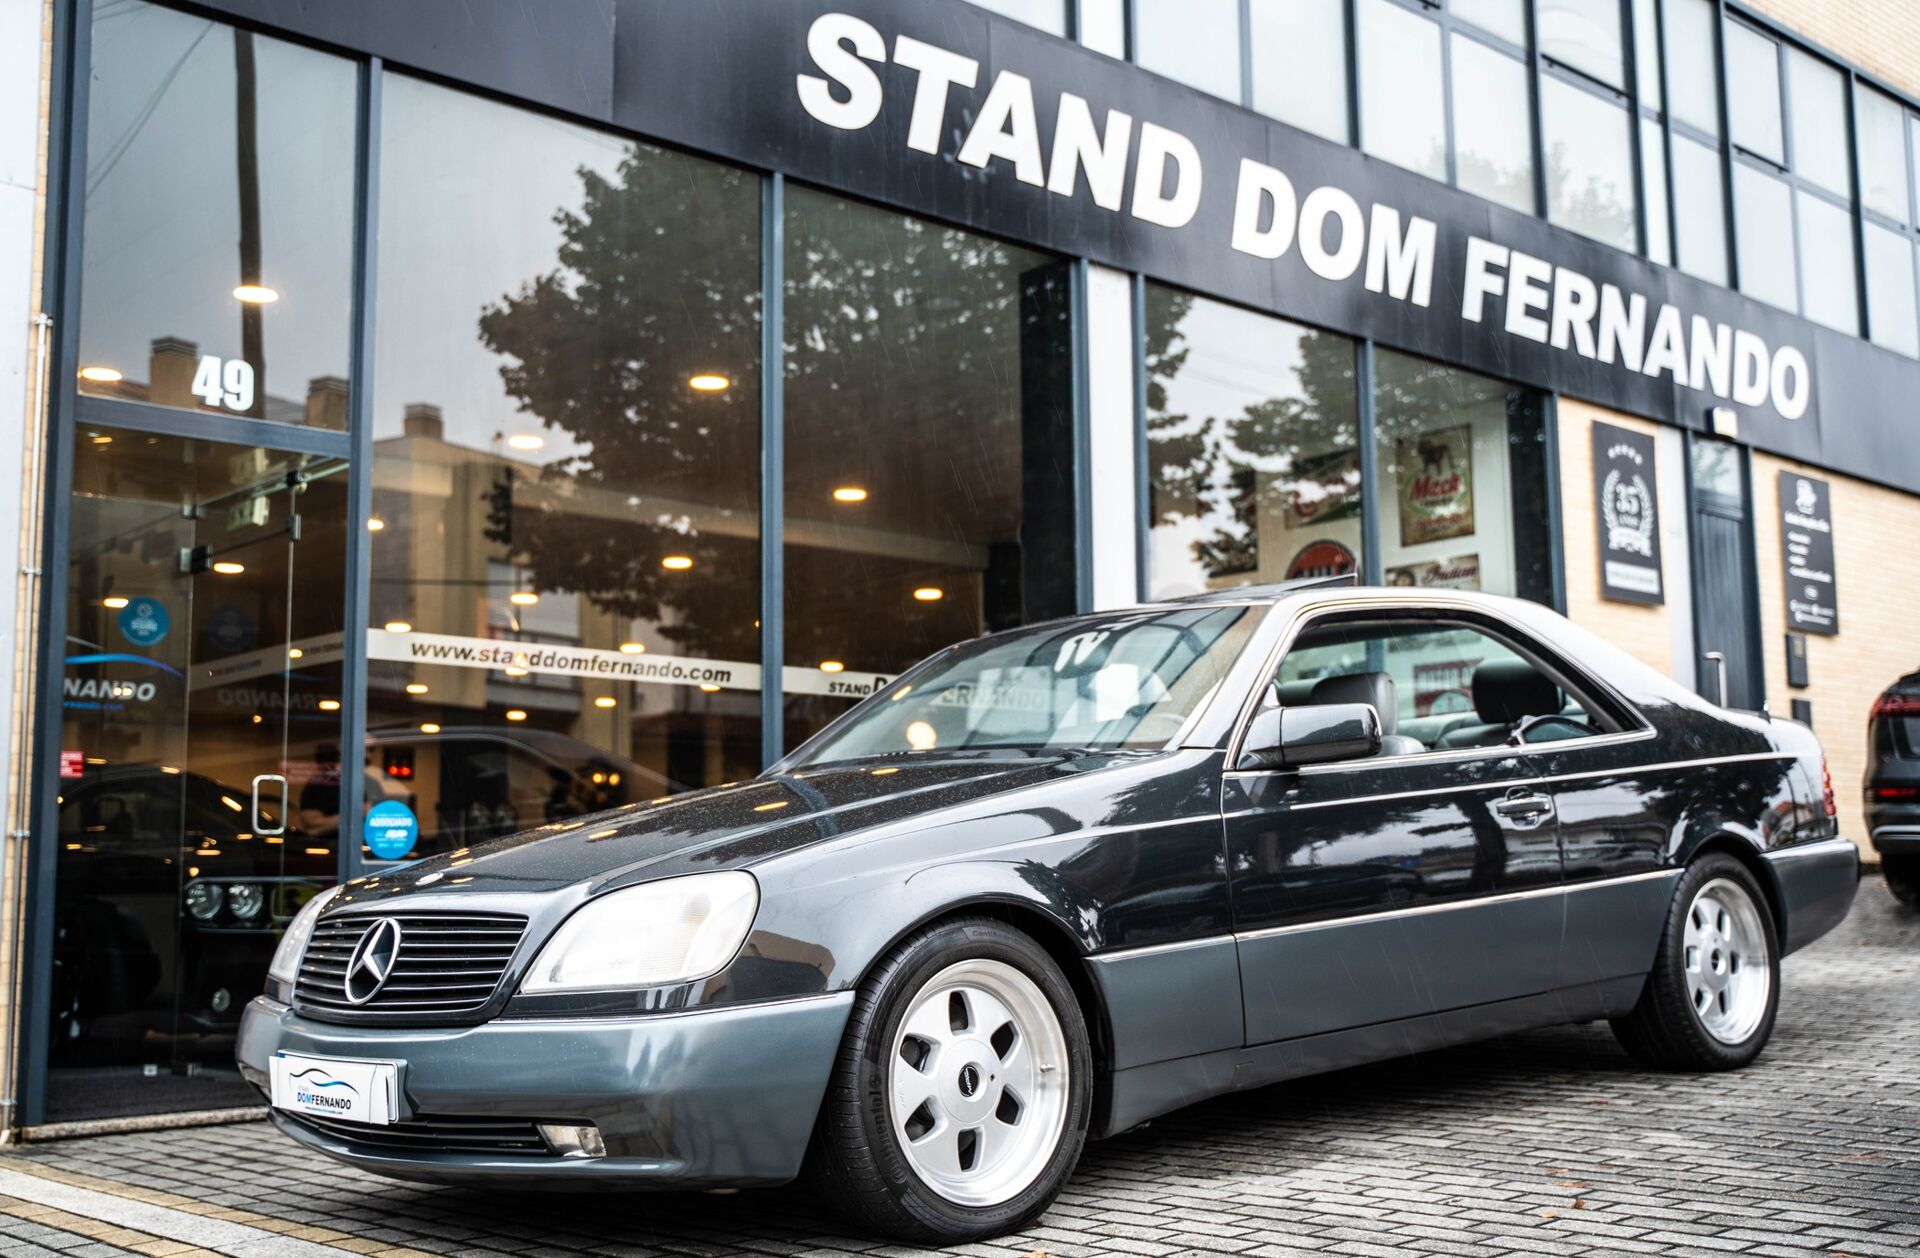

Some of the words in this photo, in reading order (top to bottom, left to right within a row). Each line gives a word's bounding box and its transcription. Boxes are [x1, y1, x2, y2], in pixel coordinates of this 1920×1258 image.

[797, 12, 1202, 229] STAND
[1231, 158, 1437, 307] DOM
[1462, 236, 1810, 421] FERNANDO
[191, 355, 255, 411] 49
[411, 642, 732, 683] www.staddomfernando.com
[828, 681, 871, 695] STAND
